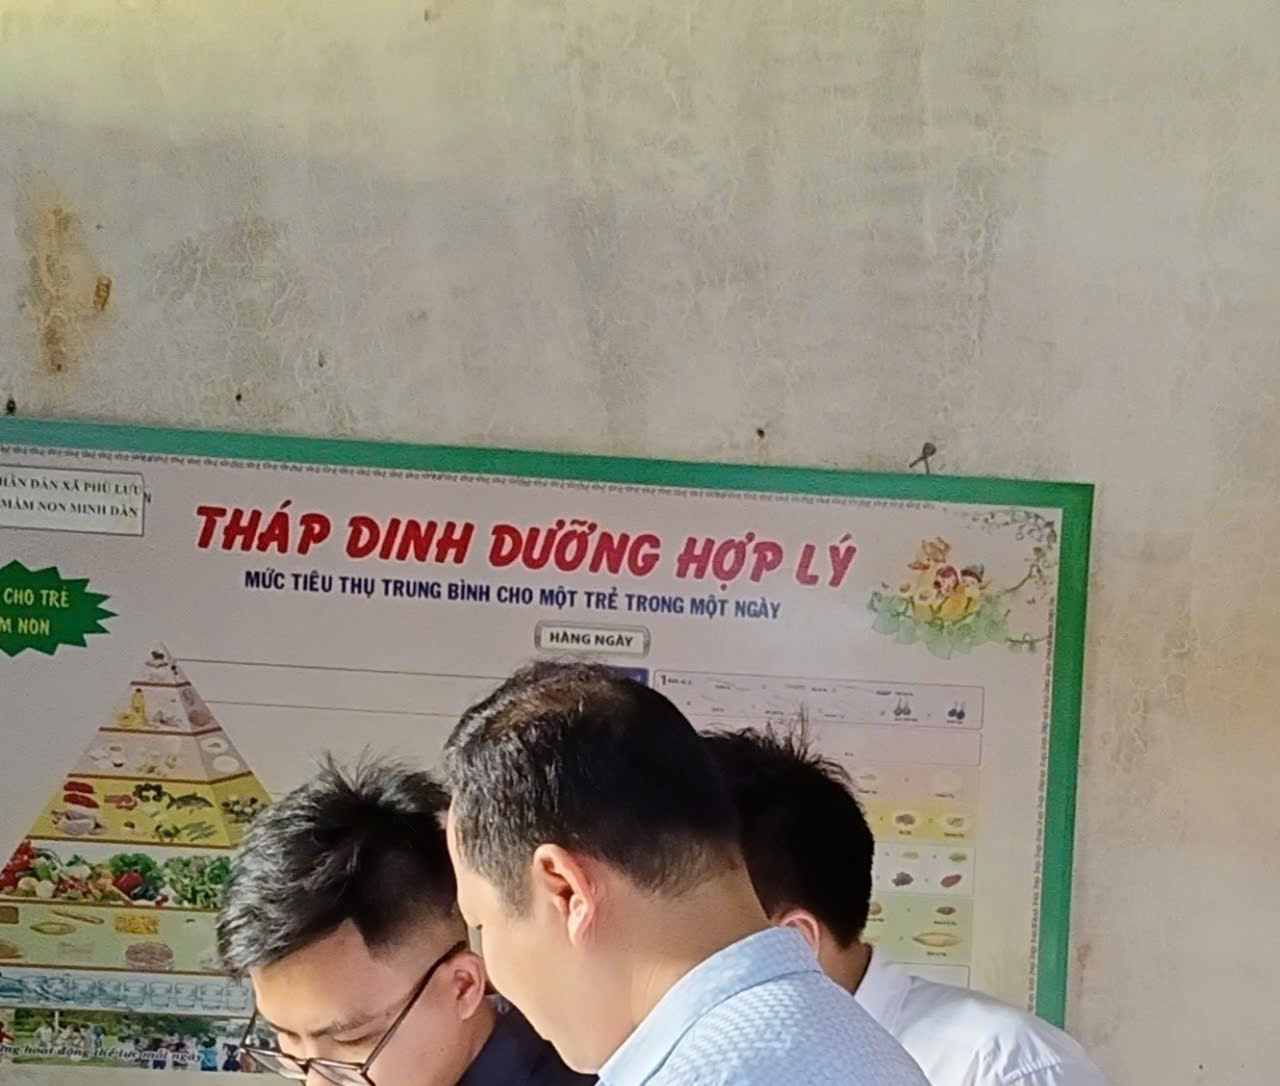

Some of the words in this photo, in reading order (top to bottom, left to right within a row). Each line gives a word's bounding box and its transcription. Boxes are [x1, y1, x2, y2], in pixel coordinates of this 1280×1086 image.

[37, 500, 67, 512] NON
[70, 503, 106, 516] MINH
[196, 499, 331, 555] THÁP
[346, 515, 475, 565] DINH
[489, 519, 661, 577] DƯỠNG
[675, 531, 784, 591] HỢP
[795, 533, 857, 588] LÝ
[3, 587, 35, 605] CHO
[244, 567, 286, 590] MỨC
[291, 569, 333, 593] TIÊU
[338, 576, 375, 599] THỤ
[381, 578, 442, 599] TRUNG
[447, 579, 490, 602] BÌNH
[496, 585, 534, 605] CHO
[539, 585, 578, 609] MỘT
[584, 585, 619, 610] TRẺ
[624, 593, 685, 614] TRONG
[689, 596, 728, 618] MỘT
[734, 597, 781, 619] NGÀY
[17, 617, 51, 636] NON
[549, 629, 591, 645] HÀNG
[594, 632, 634, 648] NGÀY
